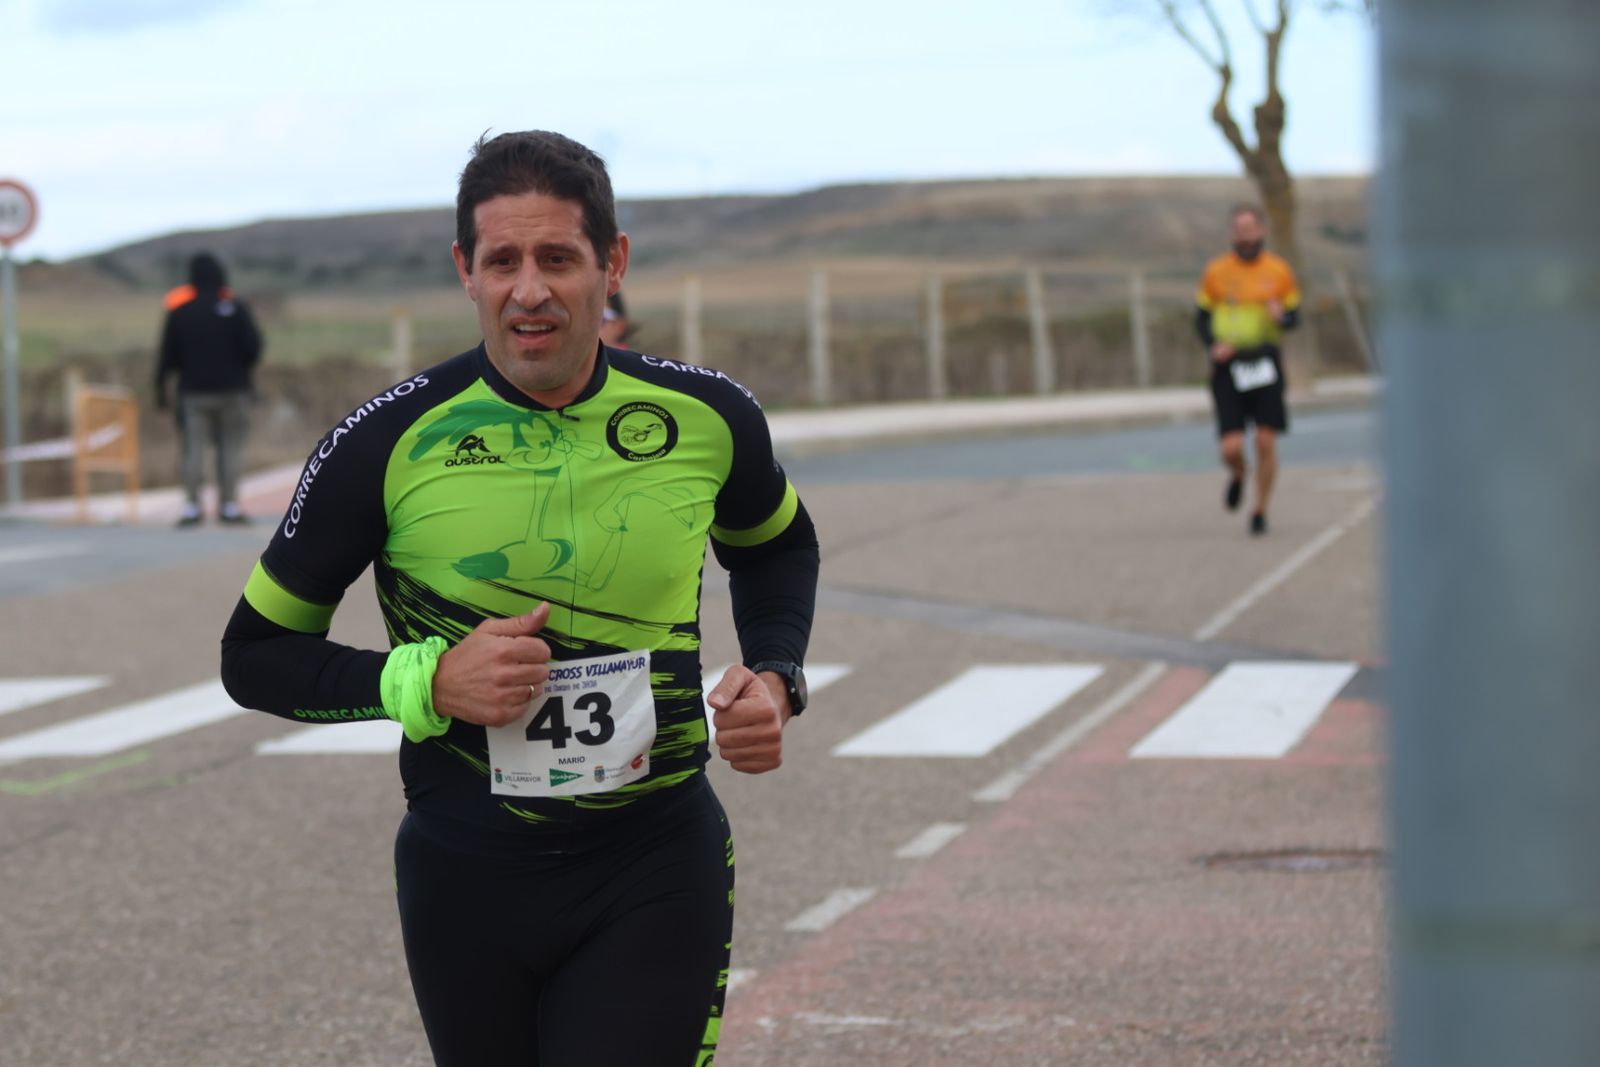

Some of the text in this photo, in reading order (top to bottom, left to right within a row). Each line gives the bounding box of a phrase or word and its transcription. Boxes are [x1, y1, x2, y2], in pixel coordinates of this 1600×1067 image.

[610, 404, 669, 426] CORRECAMINOS
[284, 374, 430, 539] CORRECAMINOS
[444, 455, 506, 467] austral
[548, 665, 583, 682] CROSS
[526, 691, 615, 749] 43
[558, 756, 586, 765] MARIO
